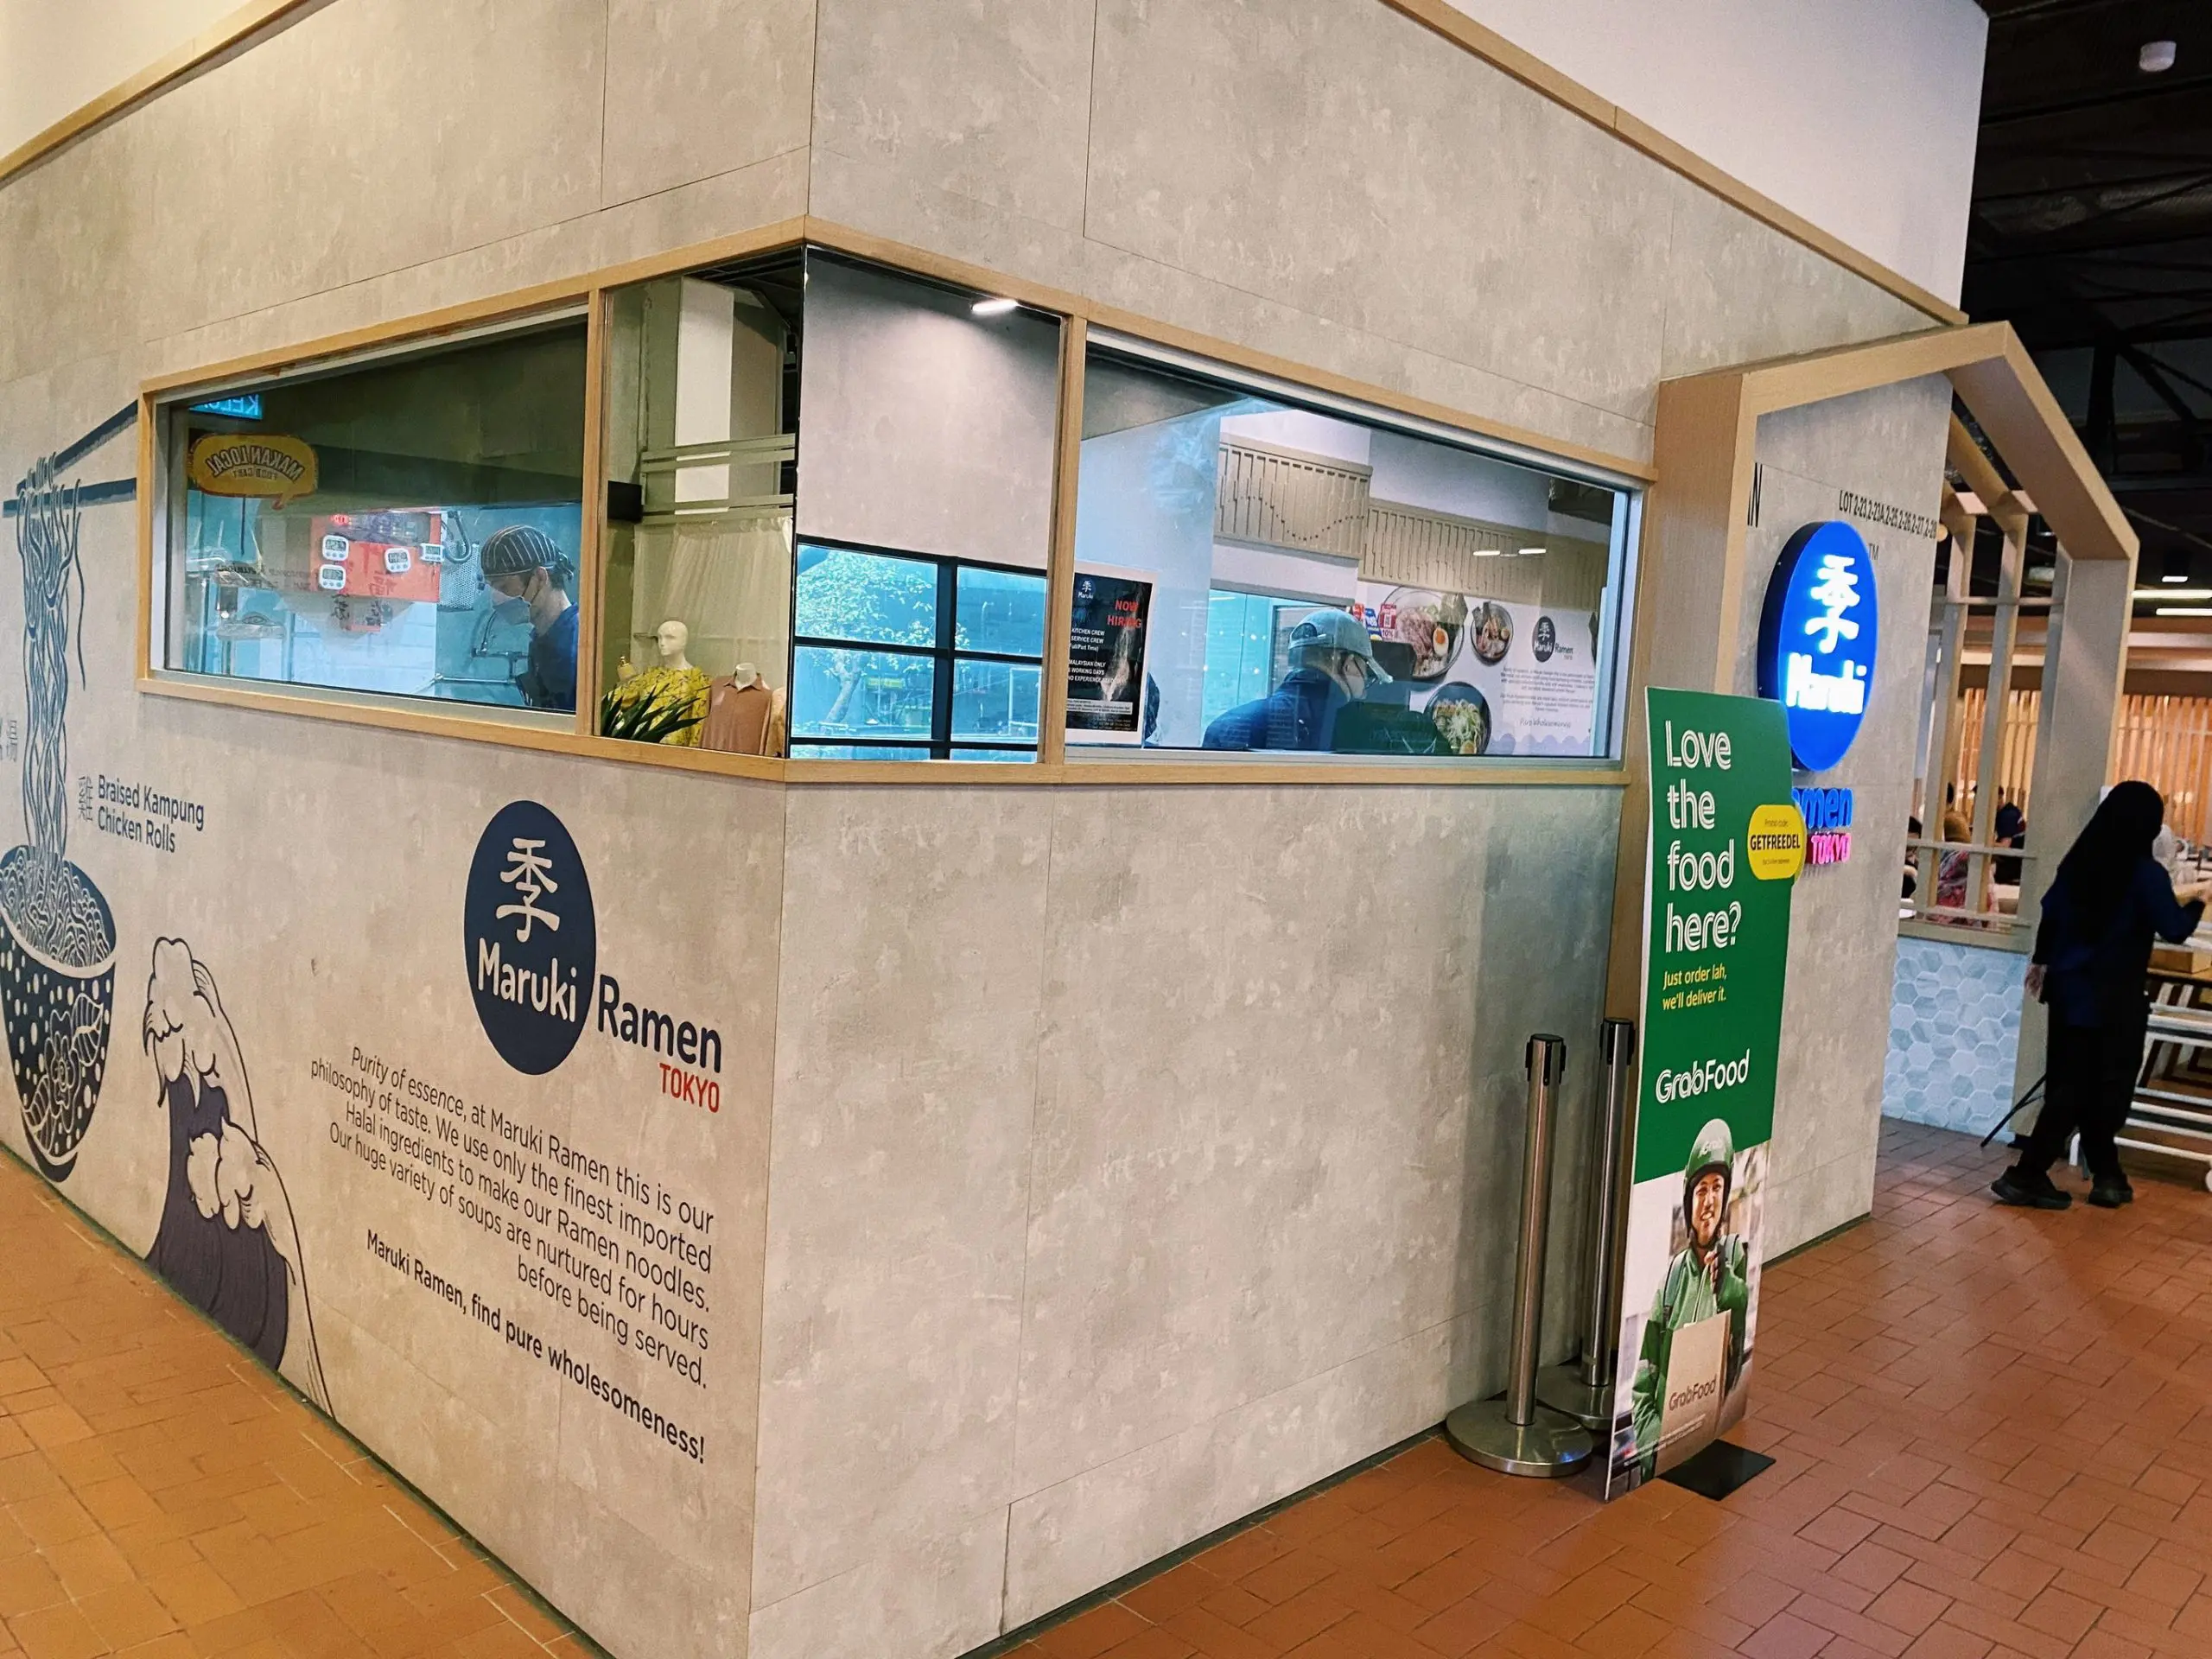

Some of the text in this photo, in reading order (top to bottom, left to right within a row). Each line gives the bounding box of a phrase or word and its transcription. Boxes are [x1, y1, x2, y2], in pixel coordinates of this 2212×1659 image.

[1839, 489, 1853, 512] LOT
[1867, 543, 1879, 561] TM
[1107, 614, 1142, 630] HIRING
[1115, 599, 1140, 613] NOW
[1804, 554, 1860, 654] 季
[1554, 642, 1573, 654] Ramen
[1786, 652, 1867, 715] Maruki
[1665, 720, 1732, 770] Love
[98, 774, 140, 809] Braised
[143, 785, 205, 831] Kampung
[98, 805, 176, 854] Chicken Rolls
[1667, 779, 1715, 830] the
[1667, 837, 1735, 892] food
[1750, 834, 1801, 851] GETFREEDEL
[1811, 832, 1853, 865] TOKYO
[496, 837, 561, 944] 季
[1665, 900, 1742, 954] here?
[478, 938, 577, 1023] Maruki
[1662, 963, 1727, 991] Just order lah,
[1662, 985, 1726, 1011] we'll deliver it.
[598, 974, 721, 1074] Ramen
[659, 1062, 720, 1113] TOKYO
[1655, 1048, 1751, 1104] GrabFood
[311, 1058, 712, 1274] philosophy of taste. We use only the finest imported
[351, 1046, 714, 1234] Purity of essence, at Maruki Ramen this is our
[346, 1101, 710, 1313] Halal ingredients to make our Ramen noodles.
[330, 1122, 709, 1351] Our huge variety of soups are nurtured for hours
[367, 1229, 705, 1465] Maruki Ramen, find pure wholesomeness!
[518, 1255, 707, 1389] before being served.
[1669, 1375, 1718, 1412] GrabFood
